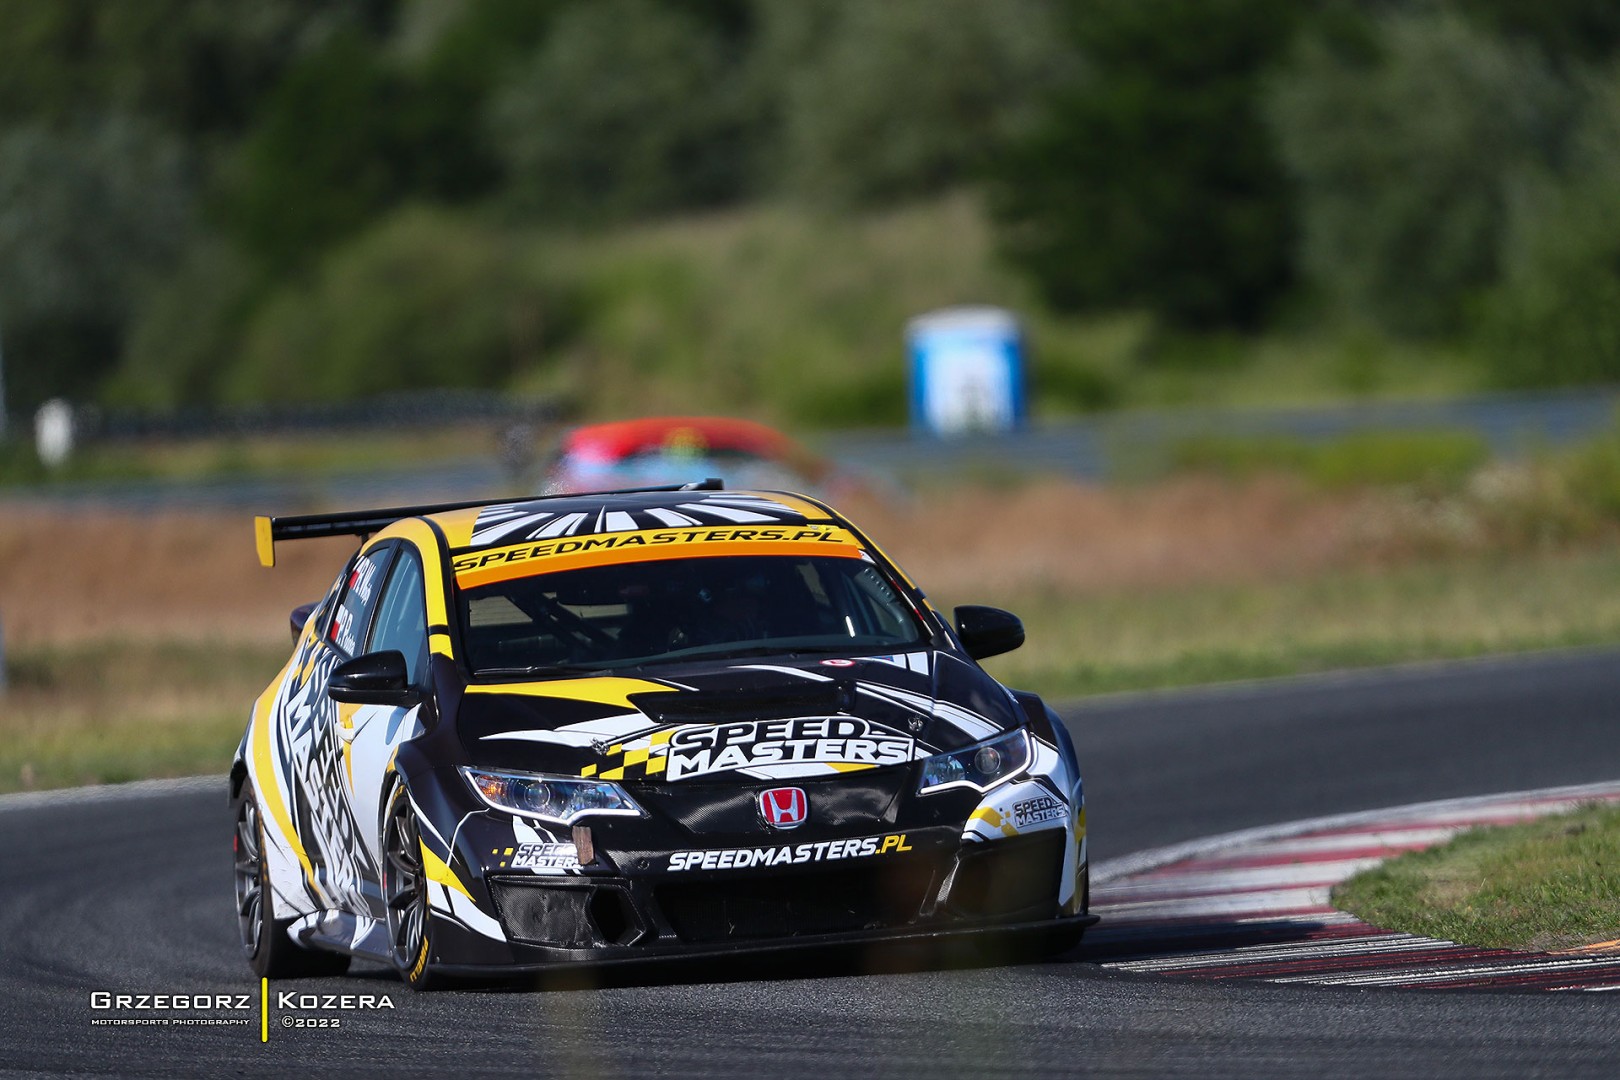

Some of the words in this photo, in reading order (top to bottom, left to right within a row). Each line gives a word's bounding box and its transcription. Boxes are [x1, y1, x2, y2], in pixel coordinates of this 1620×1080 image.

[454, 530, 843, 570] SPEEDMASTERS.PL
[670, 717, 866, 748] SPEED
[667, 739, 908, 778] MASTERS
[1014, 797, 1053, 815] SPEED
[1015, 807, 1065, 827] MASTERS
[519, 843, 577, 856] SPE
[667, 834, 912, 871] SPEEDMASTERS.PL
